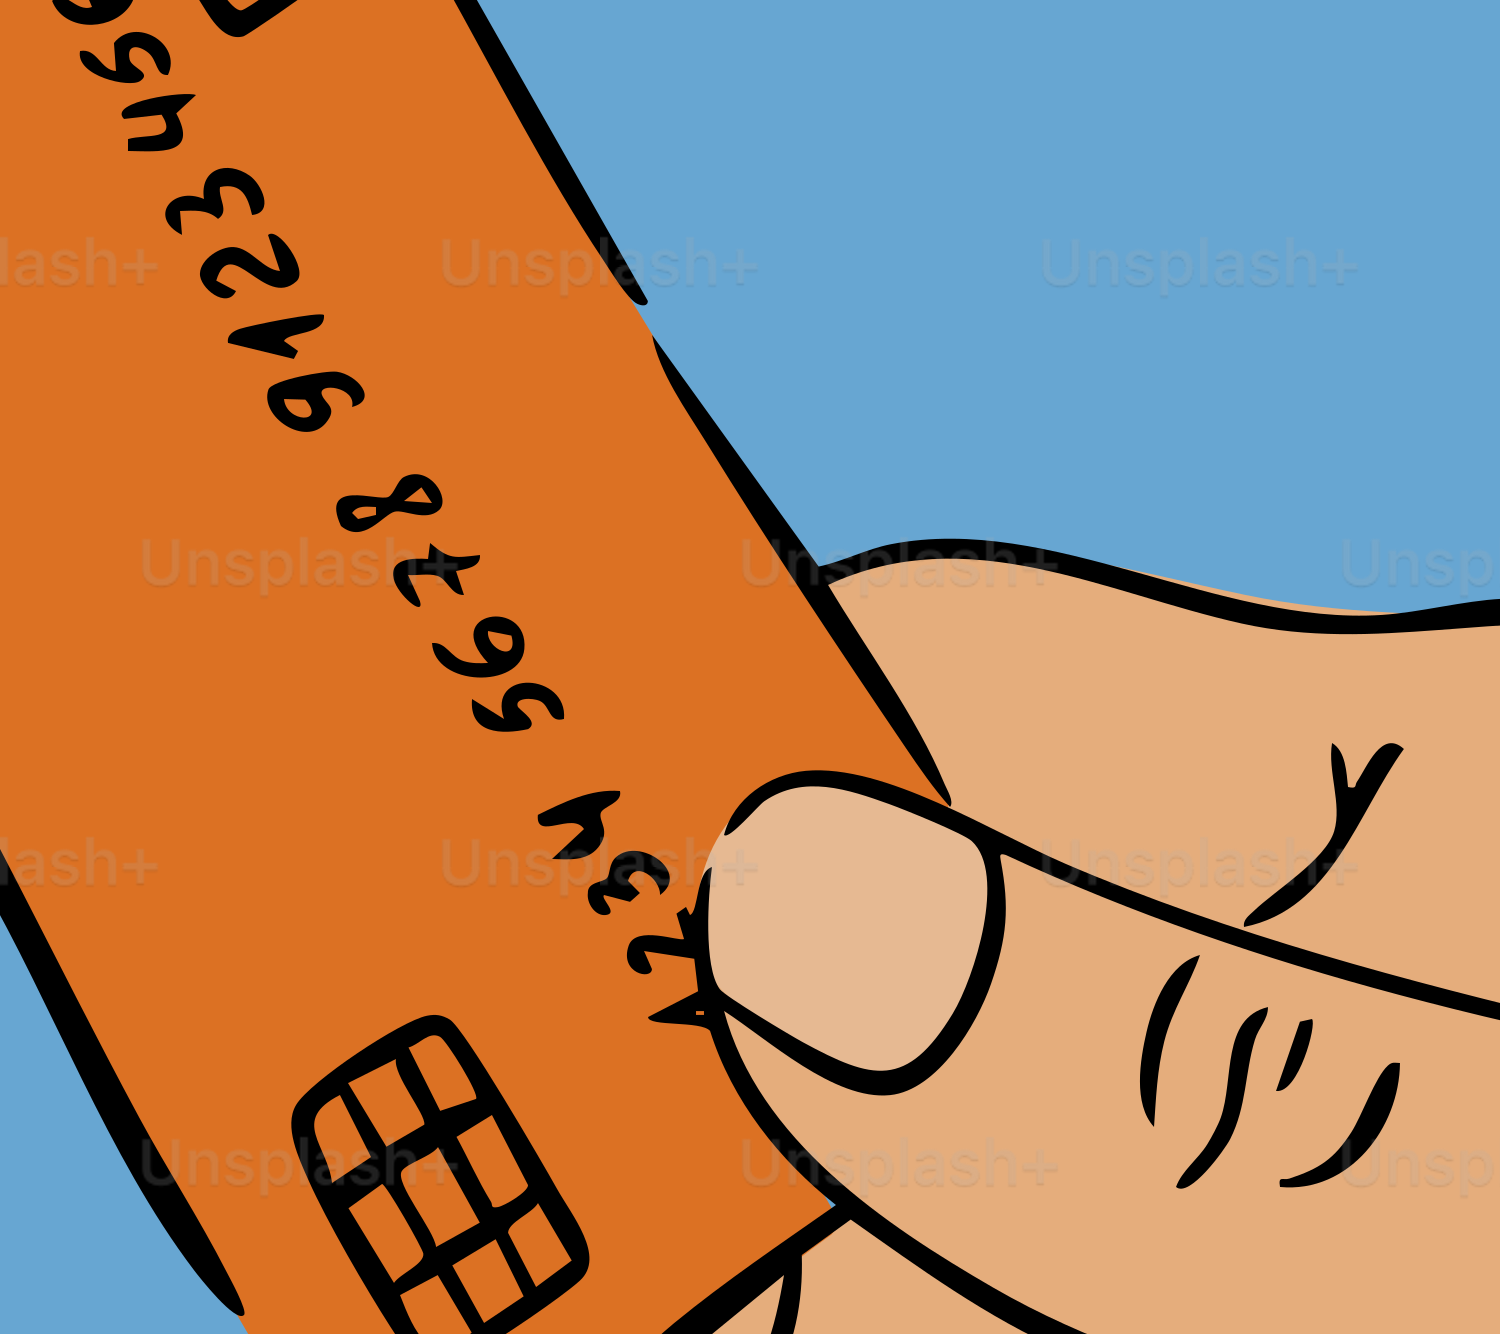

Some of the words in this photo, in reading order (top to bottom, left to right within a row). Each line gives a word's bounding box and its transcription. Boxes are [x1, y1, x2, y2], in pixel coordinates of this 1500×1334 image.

[165, 168, 366, 433] 9123
[336, 474, 564, 733] 5678
[538, 791, 712, 1031] 1234
